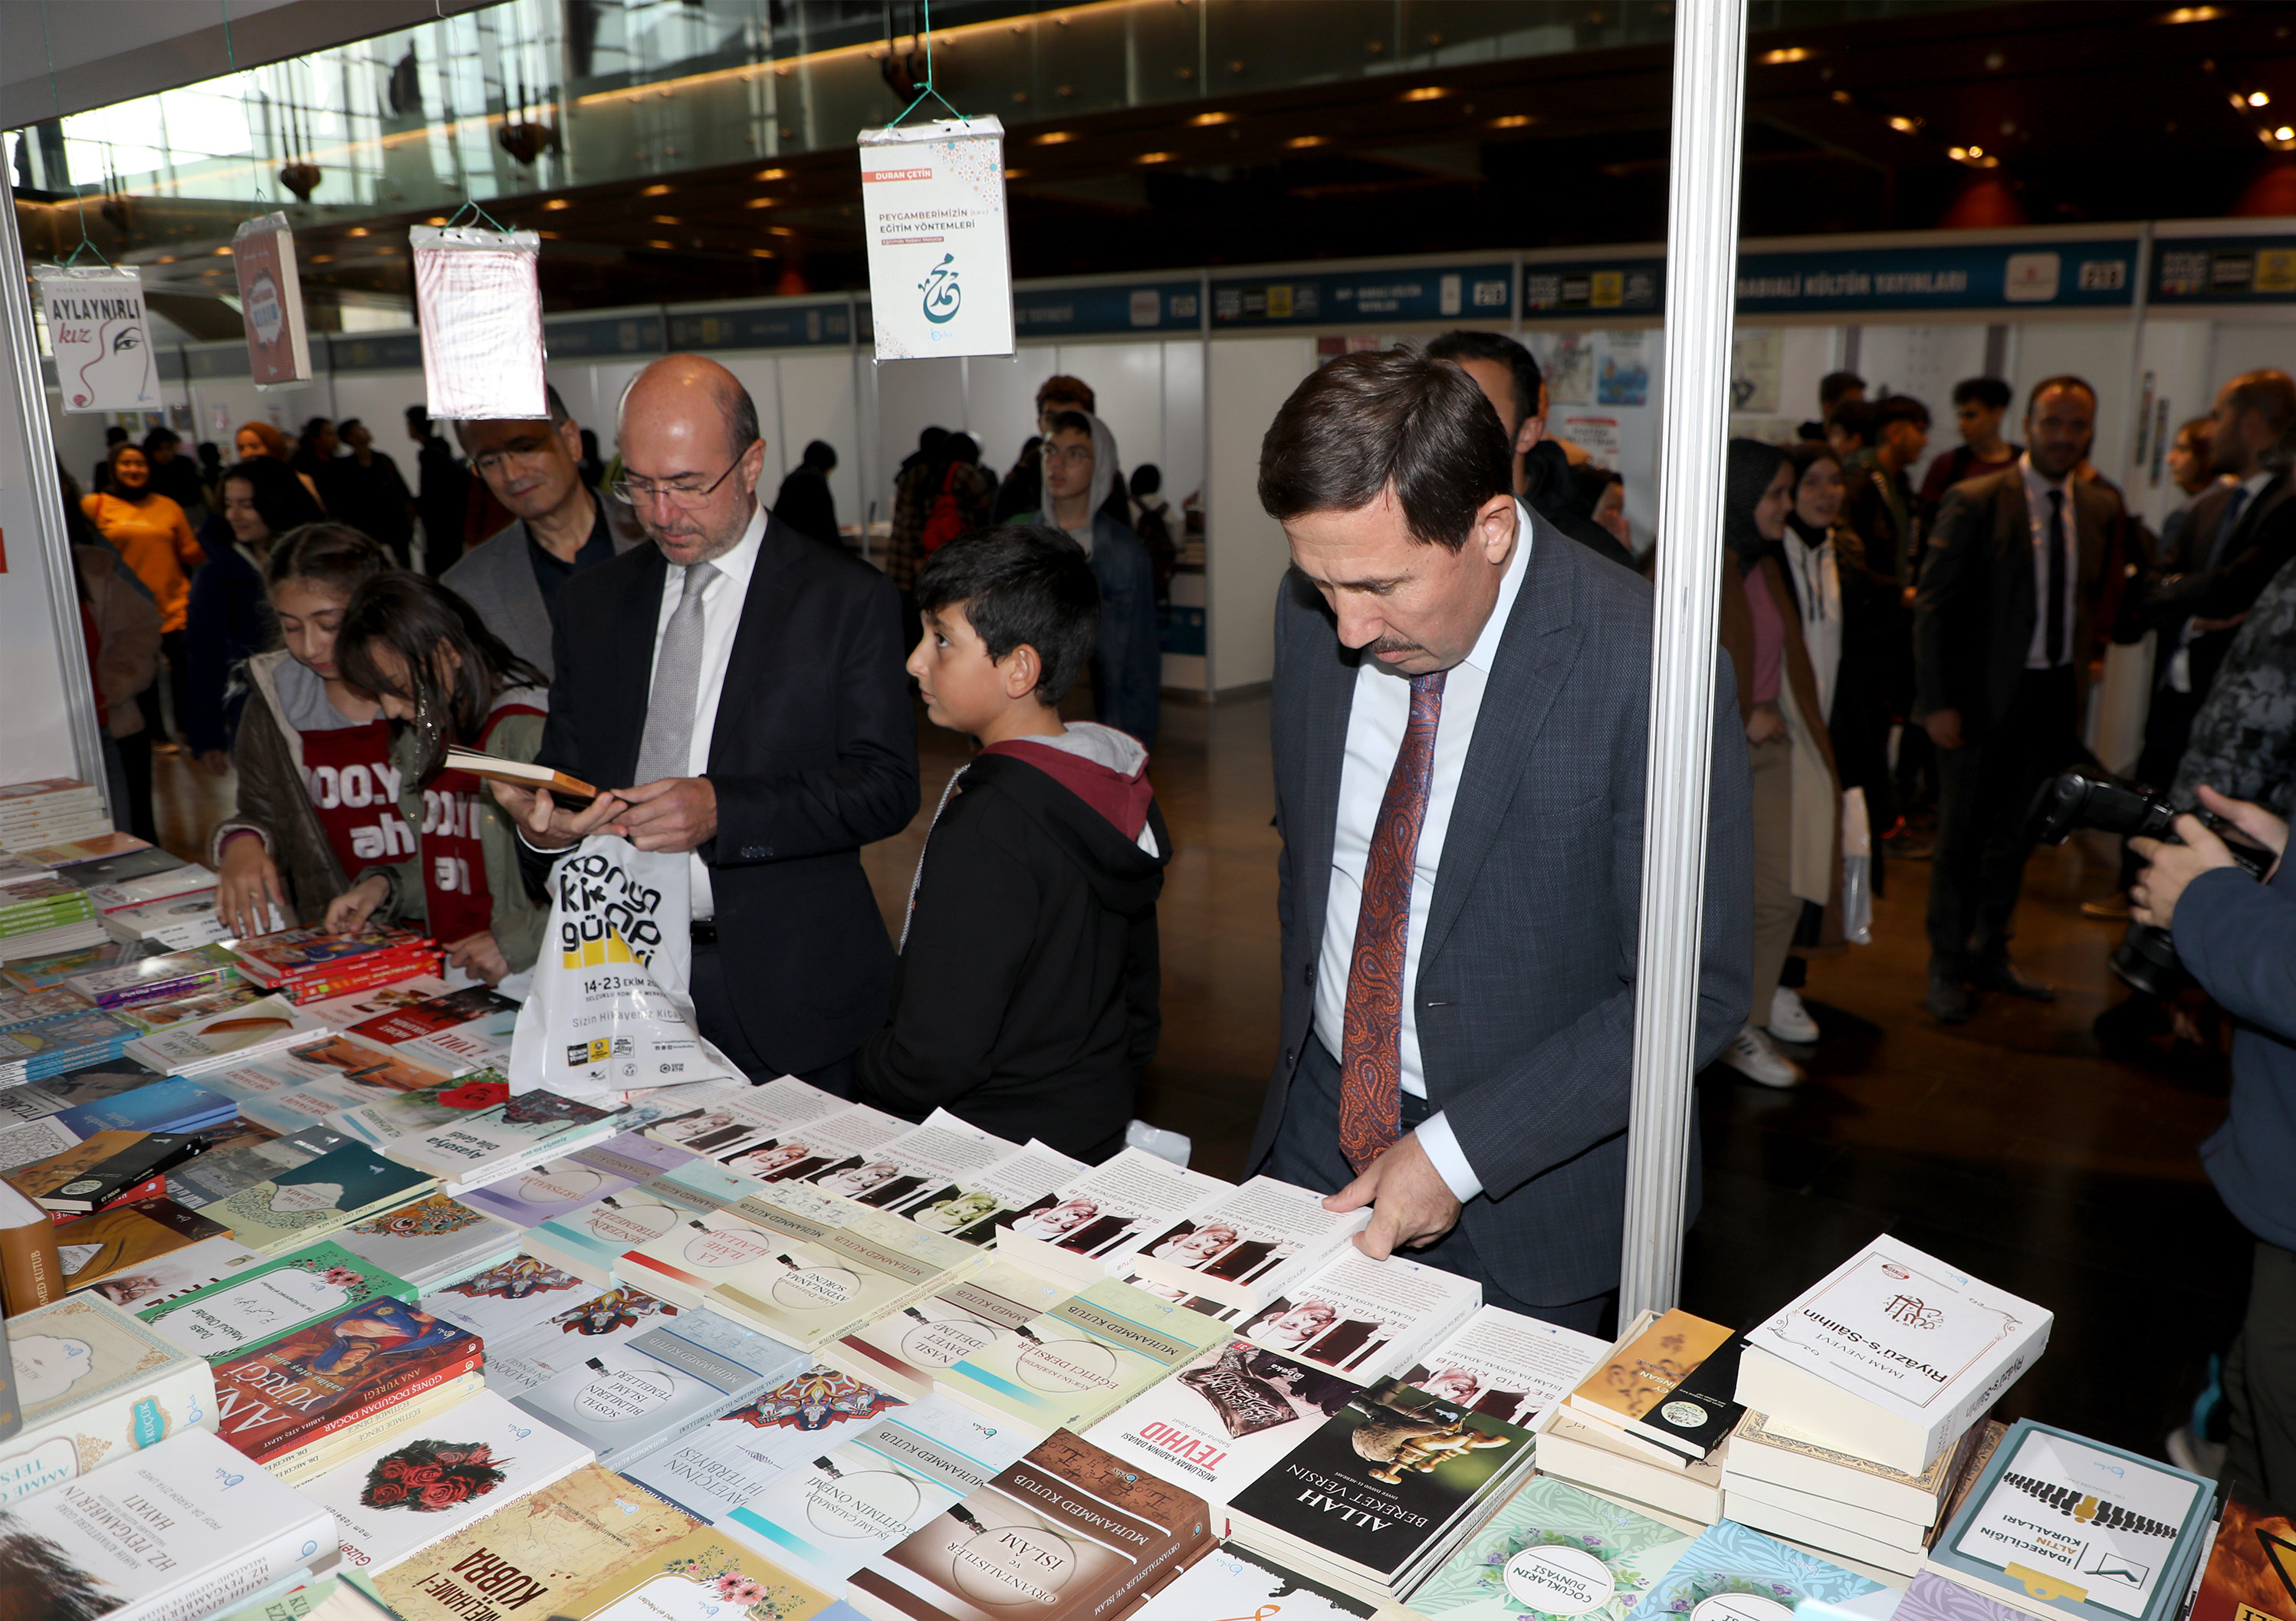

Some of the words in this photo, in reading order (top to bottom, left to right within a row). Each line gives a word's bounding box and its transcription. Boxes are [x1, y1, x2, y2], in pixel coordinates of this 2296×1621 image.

[875, 172, 905, 181] DURAN
[907, 169, 931, 180] ÇETİN
[879, 208, 967, 222] PEYGAMBERİMİZİN
[880, 223, 912, 233] EĞİTİM
[915, 221, 975, 232] YÖNTEMLERİ
[53, 299, 141, 321] AYLAYNIRLI
[58, 322, 92, 344] kız
[584, 977, 621, 993] 14-23
[623, 977, 645, 988] EKİM
[573, 1016, 598, 1028] Sizin
[427, 1136, 486, 1161] Ayasofya
[445, 1130, 480, 1147] Geldi
[476, 1135, 501, 1150] Dile
[874, 1152, 912, 1167] KUTUB
[912, 1167, 954, 1183] SEYYİD
[971, 1182, 1011, 1201] KUTUB
[1068, 1189, 1111, 1206] KUTUB
[738, 1203, 770, 1219] KUTUB
[1114, 1205, 1161, 1225] SEYYİD
[585, 1218, 645, 1245] BENZERİNİ
[769, 1215, 825, 1238] MUHAMMED
[1203, 1215, 1250, 1232] KUTUB
[706, 1228, 772, 1258] İLLALLAH
[834, 1236, 869, 1255] KUTUB
[1253, 1230, 1306, 1250] SEYYİD
[31, 1250, 43, 1280] KUTUB
[866, 1251, 925, 1277] MUHAMMED
[784, 1271, 850, 1304] AYDINLANMA
[804, 1272, 848, 1293] SORUNU
[1309, 1284, 1343, 1298] ADALET
[1298, 1291, 1349, 1308] KUTUB
[1342, 1293, 1375, 1307] SOSYAL
[1067, 1305, 1108, 1327] KUTUB
[1352, 1308, 1410, 1330] SEYYİD
[189, 1323, 215, 1340] Duası
[1105, 1323, 1179, 1356] MUHAMMED
[649, 1337, 681, 1355] KUTUB
[915, 1341, 954, 1363] NASIL
[923, 1333, 971, 1356] DAVET
[1017, 1341, 1071, 1369] DERSLER
[264, 1353, 293, 1368] alpat
[679, 1350, 741, 1383] MUHAMMED
[1436, 1356, 1490, 1378] KUTUB
[1445, 1350, 1483, 1363] ADALET
[290, 1363, 313, 1379] ateş
[401, 1369, 421, 1383] ANA
[1069, 1363, 1119, 1390] EĞİTİCİ
[1484, 1361, 1518, 1375] SOSYAL
[229, 1356, 326, 1412] YÜREĞİ
[314, 1375, 345, 1393] sabiha
[363, 1380, 399, 1401] YÜREĞİ
[412, 1374, 443, 1393] GÜNEŞ
[613, 1369, 672, 1401] TEMELLERİ
[764, 1373, 785, 1386] SOSYAL
[1495, 1376, 1556, 1400] SEYYİD
[1639, 1371, 1677, 1389] İNSAN
[1651, 1386, 1670, 1395] EY
[361, 1387, 411, 1415] DOĞUDAN
[586, 1384, 645, 1416] BİLİMLERİN
[734, 1382, 765, 1404] BİLİMLERİN
[373, 1400, 410, 1423] EĞİTİMDE
[582, 1396, 620, 1419] SOSYAL
[1094, 1404, 1122, 1425] MUHAMMED
[139, 1402, 156, 1438] KÜÇÜK
[324, 1410, 360, 1434] DOĞAR
[347, 1415, 373, 1435] DENGE
[384, 1408, 421, 1432] EĞİTİMDE
[678, 1411, 714, 1434] TEMELLERİ
[1171, 1417, 1191, 1431] Alpat
[1191, 1425, 1208, 1437] Ateş
[264, 1434, 284, 1448] ALPAT
[284, 1425, 304, 1439] ATEŞ
[358, 1422, 384, 1442] DENGE
[879, 1432, 919, 1453] KUTUB
[1120, 1432, 1149, 1450] DAVASI
[1208, 1434, 1232, 1448] Sabiha
[630, 1435, 668, 1461] MUHAMMED
[1139, 1421, 1228, 1471] TEVHİD
[1147, 1439, 1178, 1464] KADININ
[608, 1457, 631, 1472] KUTUB
[672, 1447, 747, 1488] TERBİYESİ
[918, 1451, 986, 1488] MUHAMMED
[1177, 1456, 1217, 1483] MÜSLÜMAN
[13, 1465, 69, 1497] AMME
[805, 1476, 852, 1504] ÖNEMİ
[1013, 1474, 1063, 1504] KUTUB
[1286, 1463, 1351, 1498] VERSİN
[170, 1490, 194, 1509] EKREM
[805, 1491, 858, 1523] ÇALIŞMADA
[1295, 1488, 1393, 1533] ALLAH
[1347, 1492, 1429, 1527] BEREKET
[60, 1486, 153, 1554] PEYGAMBER'İN
[122, 1494, 176, 1531] HAYATI
[851, 1500, 915, 1538] EĞİTİMİN
[1061, 1499, 1150, 1546] MUHAMMED
[2002, 1514, 2081, 1547] KURALLARI
[998, 1532, 1066, 1573] İSLÂM
[1979, 1525, 2072, 1567] İDARECİLİĞİN
[2035, 1537, 2077, 1556] ALTIN
[146, 1550, 177, 1572] HZ.
[248, 1564, 268, 1579] HZ.
[1008, 1560, 1021, 1570] ve
[1125, 1543, 1181, 1590] ORYANTALİSTLER
[451, 1547, 549, 1612] KÜBRA
[947, 1541, 1057, 1604] ORYANTALİSTLER
[1532, 1565, 1587, 1591] DÜNYASI
[1115, 1587, 1126, 1597] VE
[1513, 1567, 1592, 1604] ÇOCUKLARIN
[1093, 1593, 1116, 1616] İSLAM
